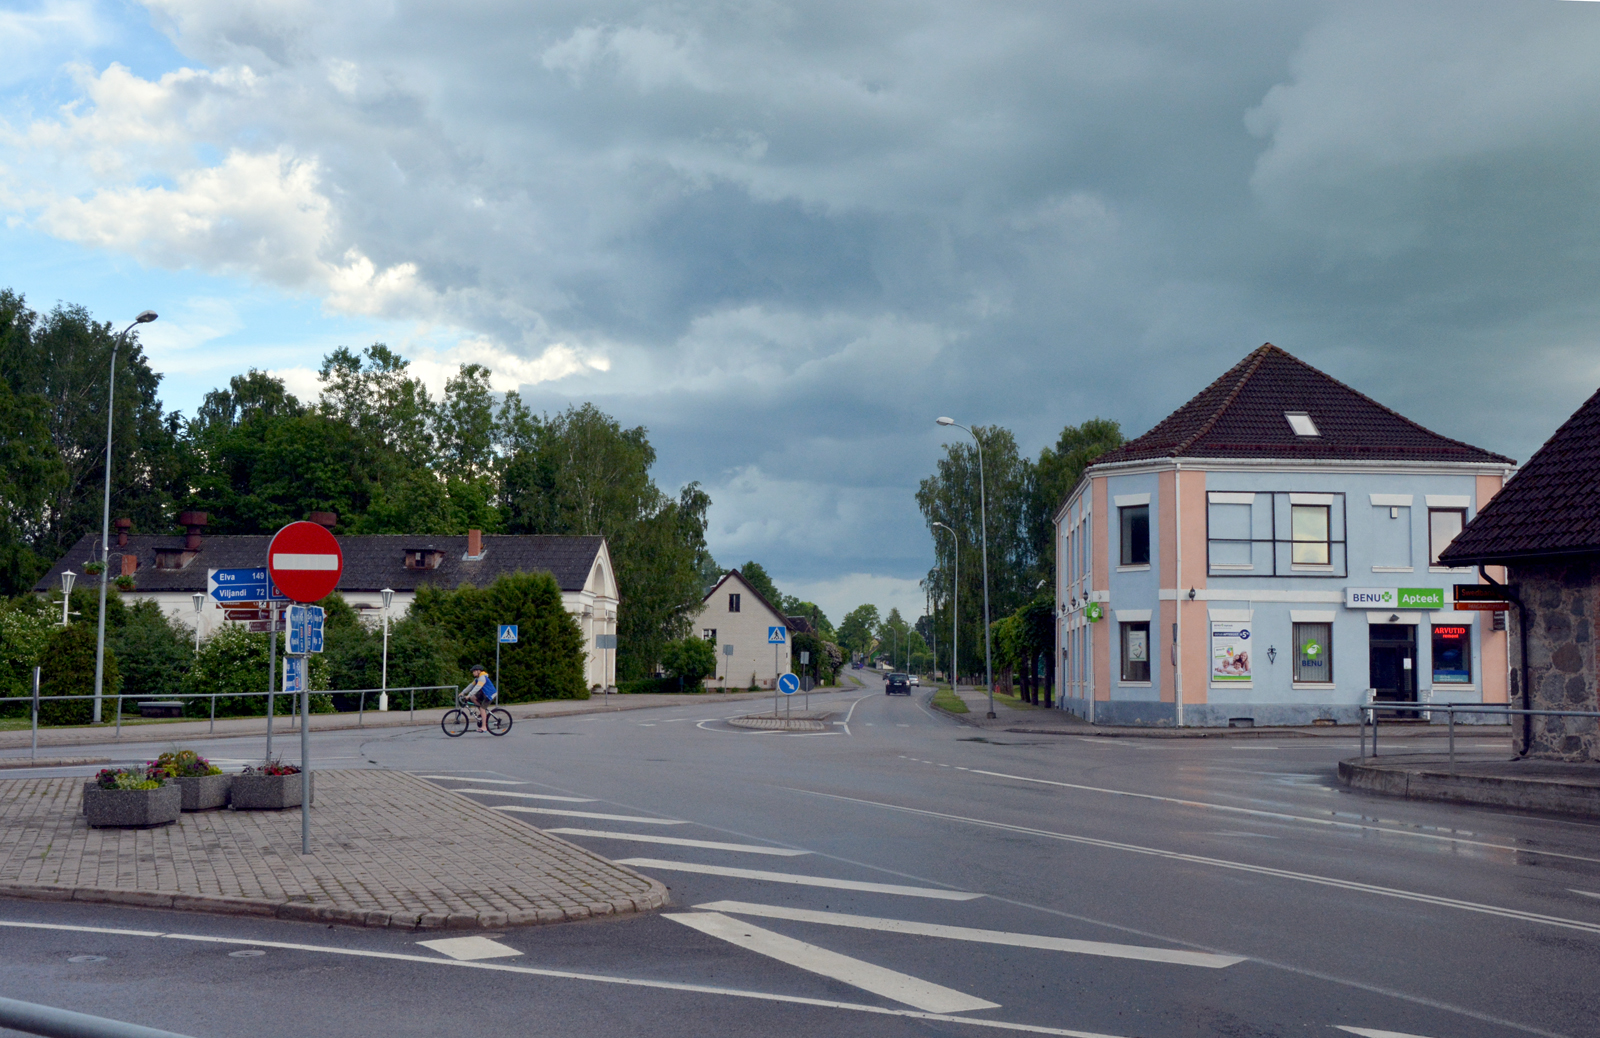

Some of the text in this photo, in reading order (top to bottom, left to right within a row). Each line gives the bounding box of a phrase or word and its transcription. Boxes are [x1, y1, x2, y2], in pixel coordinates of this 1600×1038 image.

[220, 588, 246, 598] Viljandi
[1353, 594, 1440, 604] BENU Apteek
